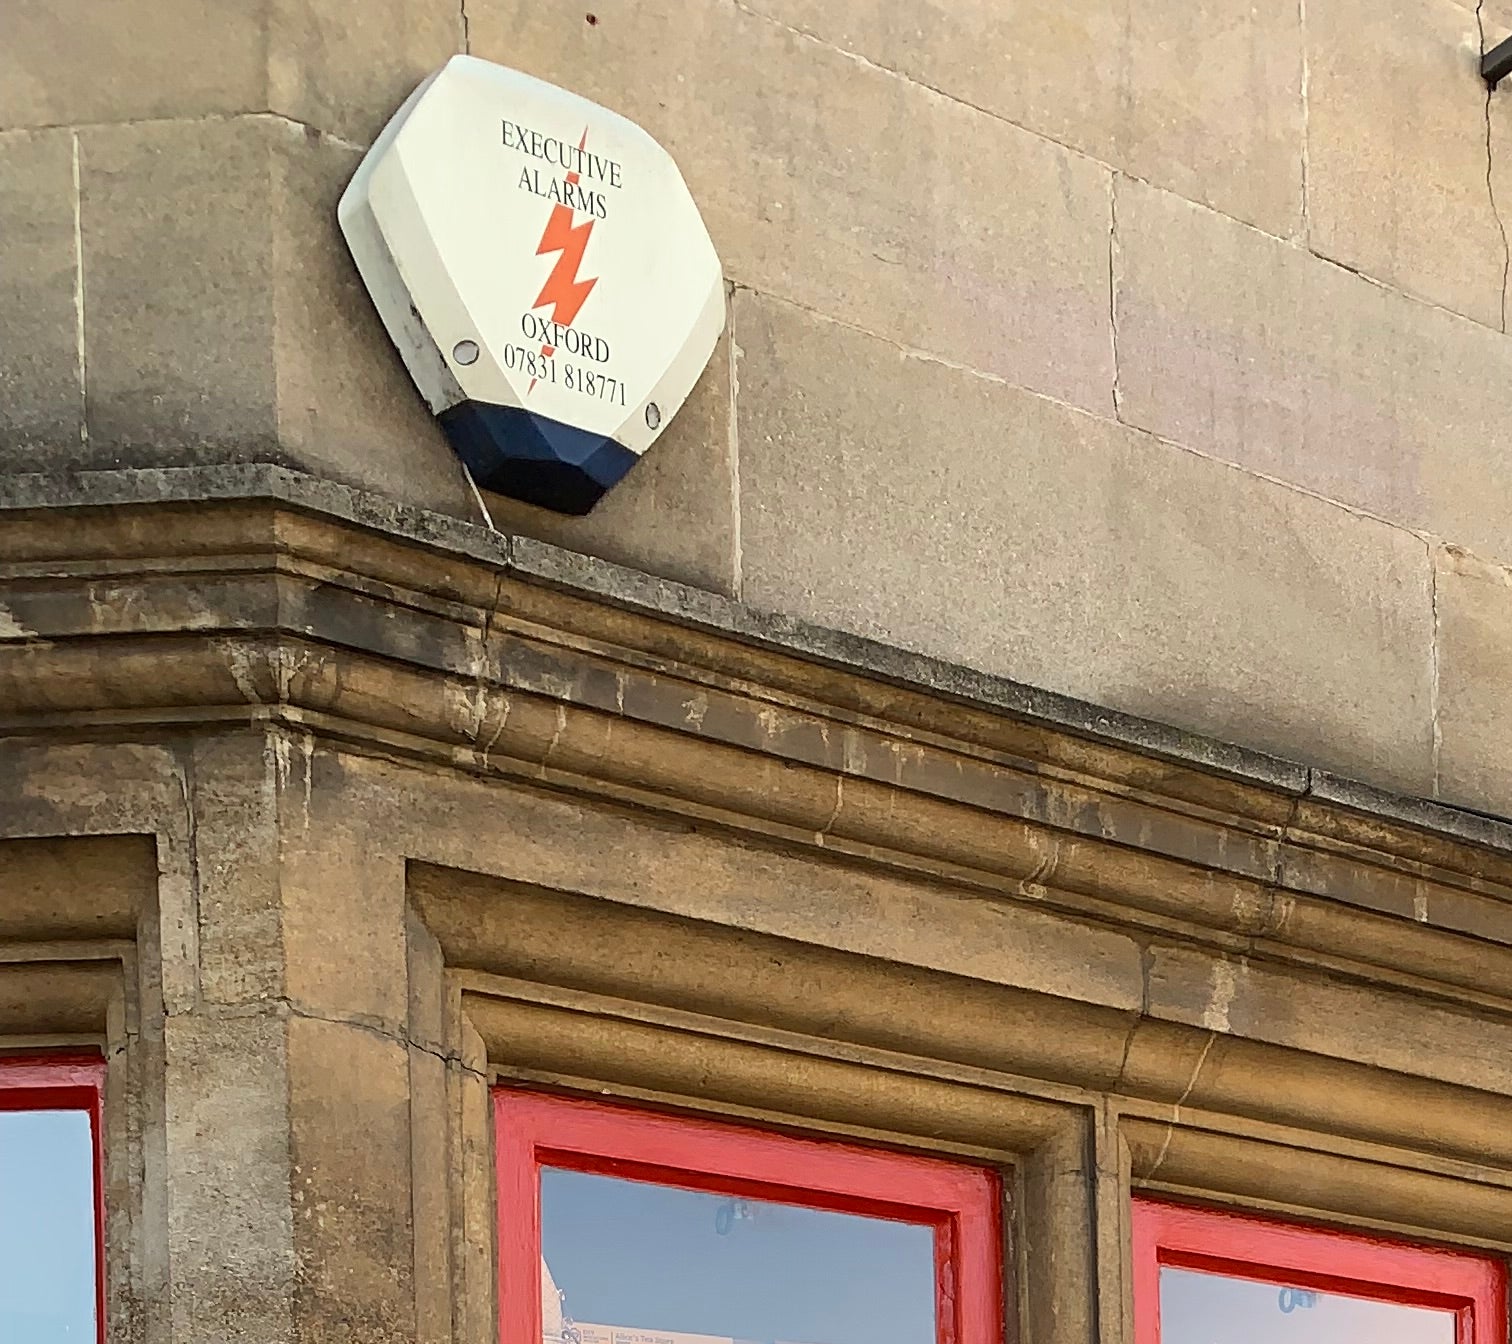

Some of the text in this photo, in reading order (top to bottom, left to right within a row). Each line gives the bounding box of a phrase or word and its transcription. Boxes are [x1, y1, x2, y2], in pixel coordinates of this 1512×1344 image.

[501, 119, 622, 188] EXECUTIVE
[518, 166, 607, 219] ALARMS
[521, 312, 610, 363] OXFORD
[504, 343, 627, 406] 07831 818771
